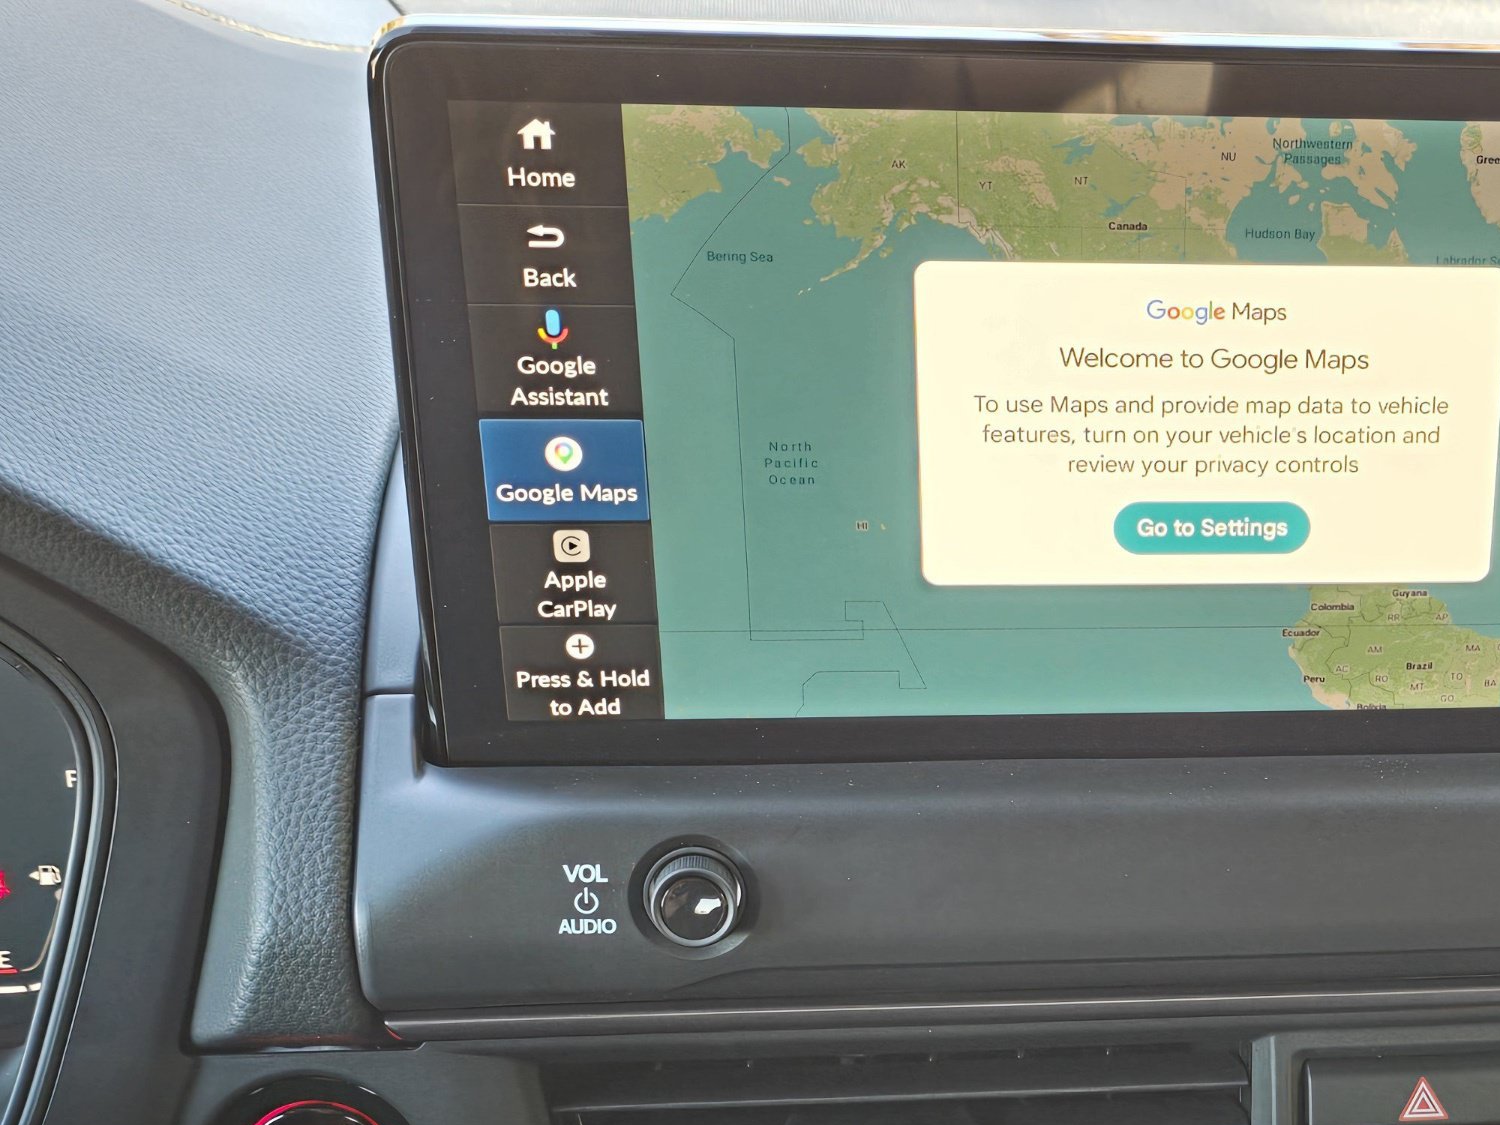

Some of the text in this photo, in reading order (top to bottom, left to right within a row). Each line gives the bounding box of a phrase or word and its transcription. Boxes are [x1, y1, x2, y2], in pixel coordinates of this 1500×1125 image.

[1272, 137, 1353, 150] Northwestern
[891, 159, 906, 170] AK
[1284, 153, 1342, 168] Passages
[507, 167, 576, 189] Home
[1108, 221, 1148, 232] Canada
[1245, 227, 1316, 242] Hudson Bay
[706, 250, 774, 266] Bering Sea
[523, 269, 577, 288] Back
[1146, 300, 1287, 325] Google Maps
[517, 356, 596, 379] Google
[1060, 347, 1369, 375] Welcome to Google Maps
[511, 387, 609, 407] Assistant
[974, 395, 1449, 420] To use Maps and provide map data to vehicle
[983, 425, 1440, 450] features, turn on your vehicle's location and
[768, 441, 812, 453] North
[764, 457, 819, 469] Pacific
[1068, 456, 1359, 479] review your privacy controls
[768, 474, 816, 486] Ocean
[496, 484, 638, 506] Google Maps
[1136, 518, 1288, 541] Go to Settings
[544, 571, 607, 592] Apple
[1392, 589, 1428, 598] Guyana
[537, 601, 617, 622] CarPlay
[1310, 603, 1355, 611] Colombia
[1282, 628, 1321, 637] Ecuador
[1406, 661, 1433, 670] Brazil
[517, 669, 650, 688] Press & Hold
[1303, 675, 1326, 683] Peru
[550, 698, 621, 716] to Add
[65, 769, 78, 788] F
[562, 864, 609, 884] VOL
[558, 918, 618, 935] AUDIO
